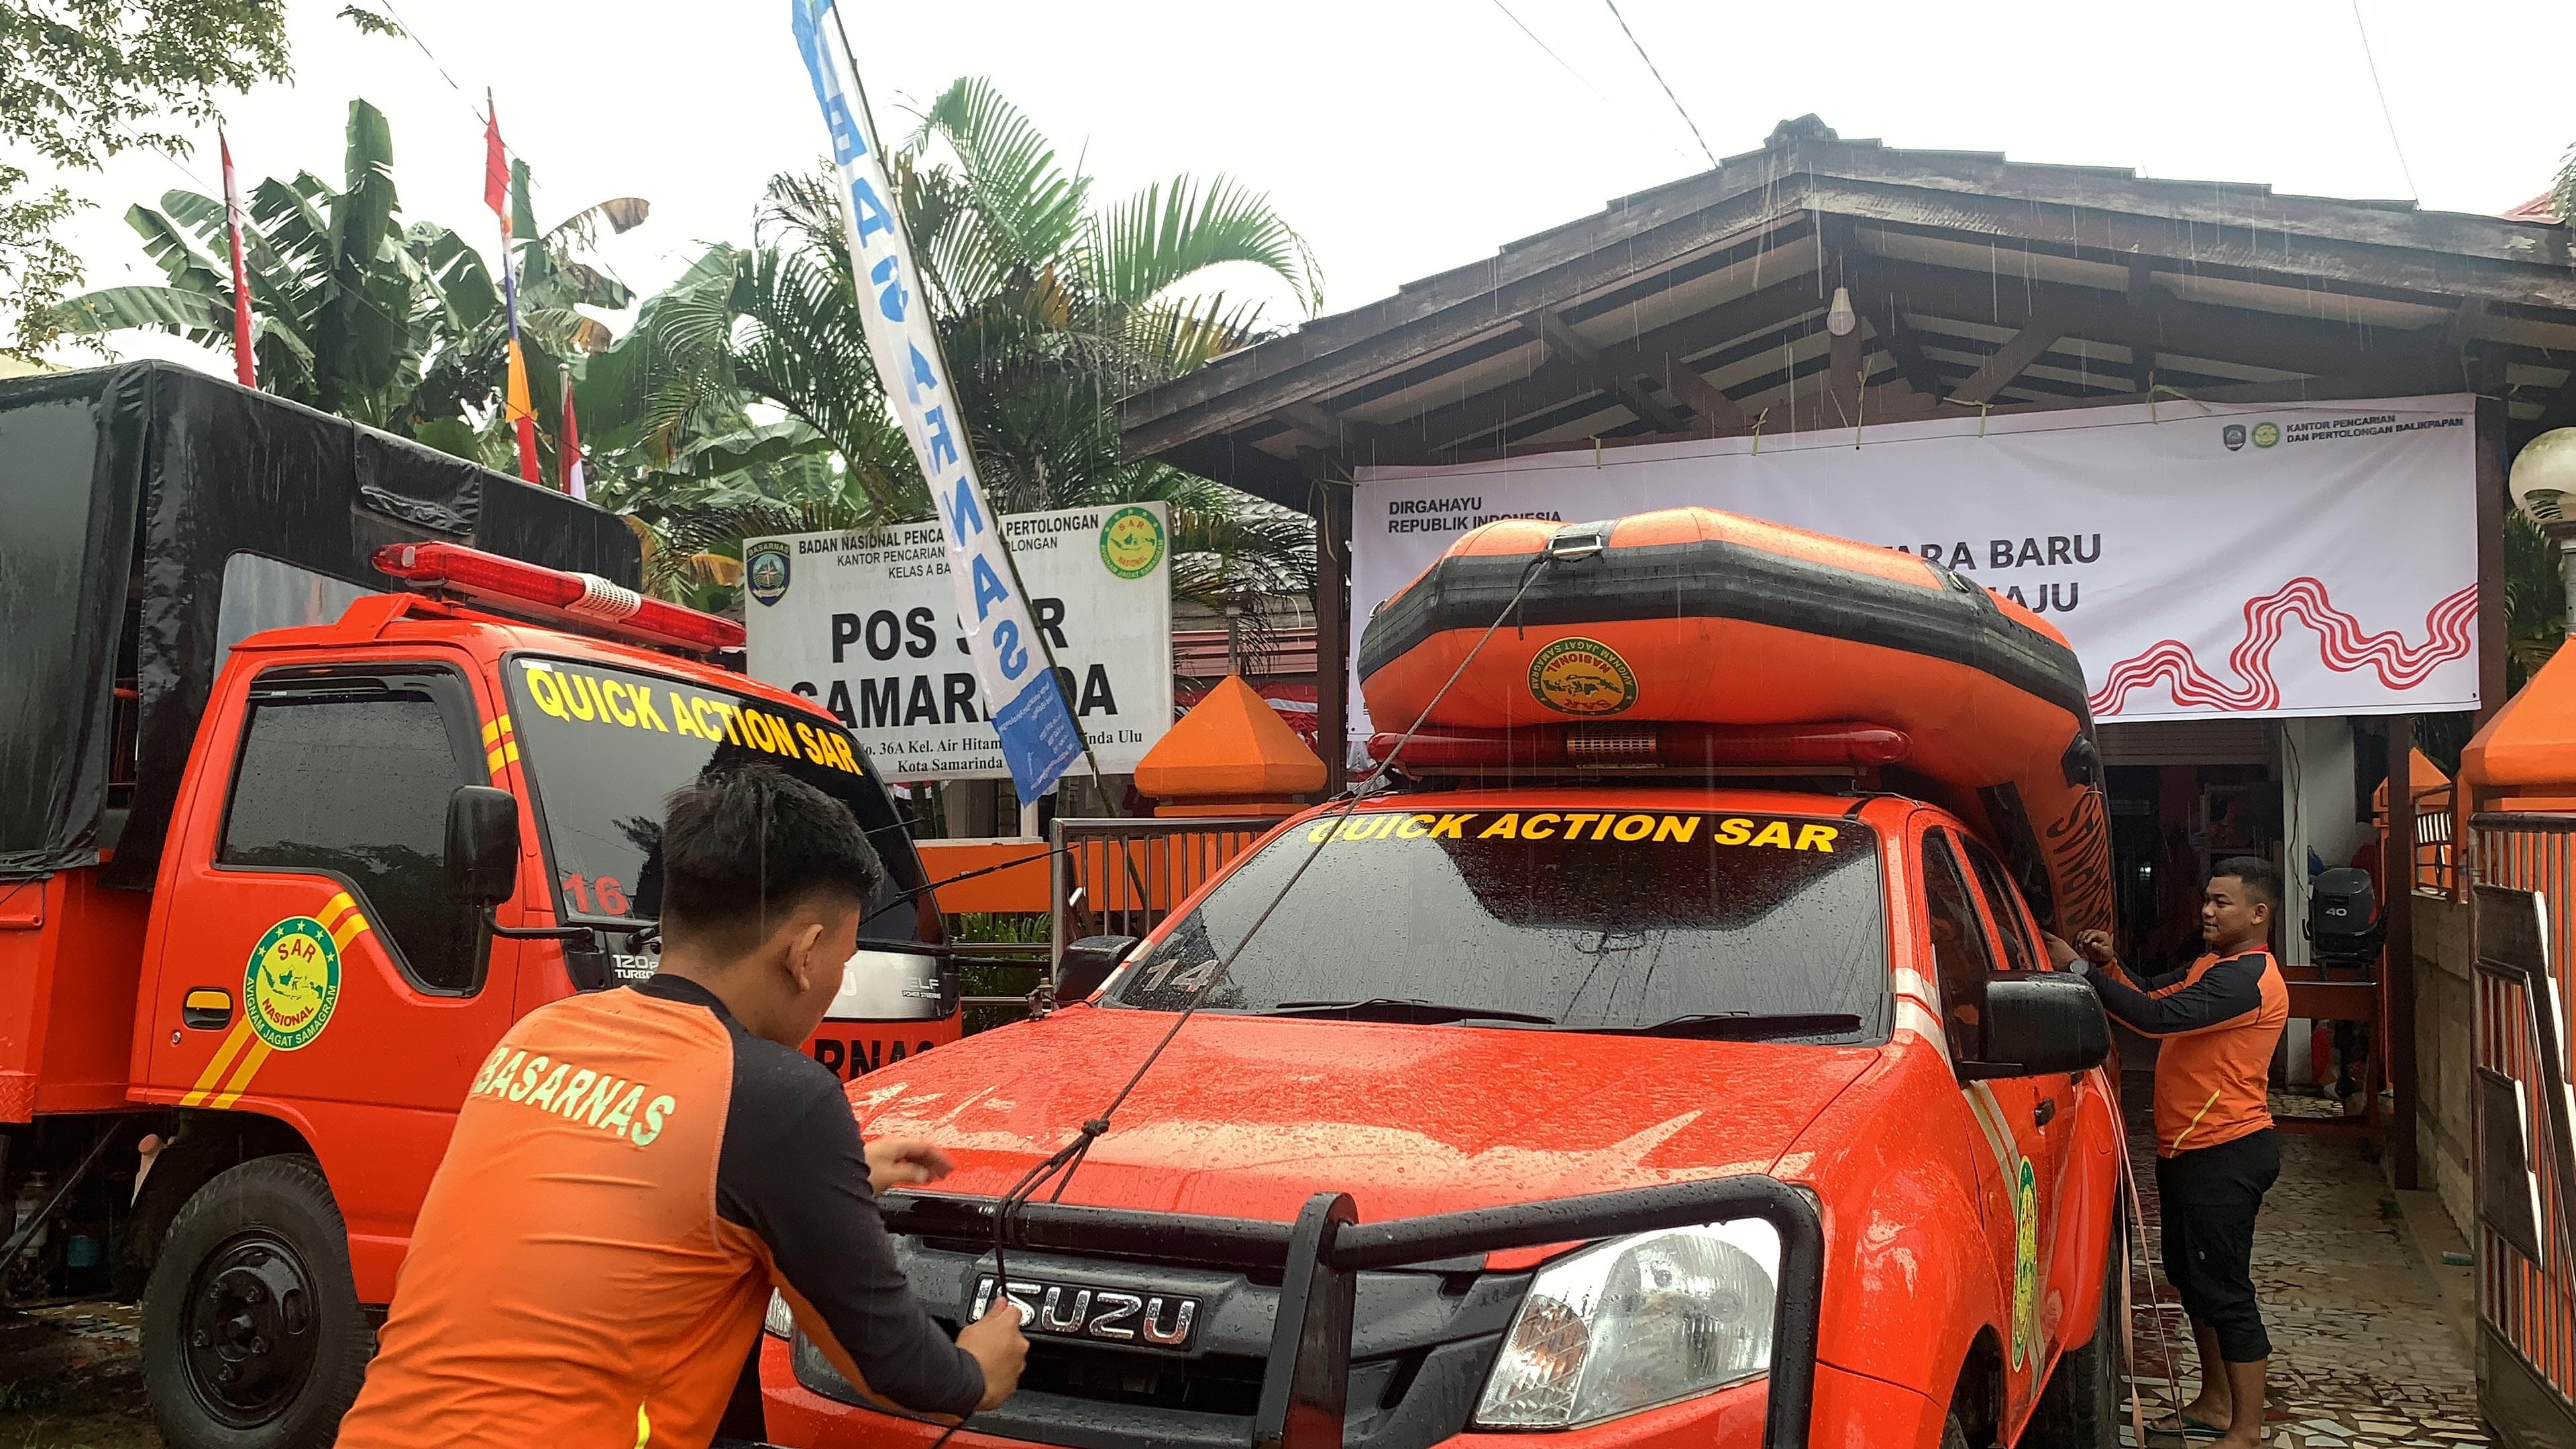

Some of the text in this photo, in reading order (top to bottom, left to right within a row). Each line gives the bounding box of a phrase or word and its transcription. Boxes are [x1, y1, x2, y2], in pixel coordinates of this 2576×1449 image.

[2286, 415, 2396, 433] KANTOR PENCARIAN
[2287, 418, 2464, 443] DAN PERTOLONGAN BALIKPAPAN
[1389, 496, 1482, 515] DIRGAHAYU
[799, 514, 1099, 554] BADAN NASIONAL PENCA PERTOLONGAN
[1118, 519, 1144, 531] SAR
[1388, 517, 1468, 533] REPUBLIK
[837, 537, 1058, 566] KANTOR PENCARIAN LONGAN
[1990, 533, 2102, 569] BARU
[889, 565, 923, 579] KELAS
[926, 564, 934, 576] A
[1988, 582, 2079, 613] AJU
[831, 606, 937, 663] POS
[1564, 641, 1599, 651] JAGAT
[1546, 653, 1611, 674] NASIONAL
[1564, 698, 1611, 710] SAR
[526, 667, 864, 776] QUICK ACTION SAR
[879, 741, 904, 755] 36A
[908, 741, 933, 753] Kel.
[937, 739, 959, 752] Air
[963, 737, 1002, 751] Hitam
[1118, 730, 1142, 743] Ulu
[898, 757, 1004, 773] Kota Samarinda
[1307, 813, 1839, 853] QUICK ACTION SAR
[562, 872, 630, 917] 16
[2325, 908, 2347, 916] 40
[278, 938, 316, 963] SAR
[614, 969, 655, 979] TURBO
[906, 977, 939, 990] ELF
[1142, 959, 1220, 992] 14
[246, 976, 337, 1046] AVIGNAM JAGAT SAMAGRAM
[262, 998, 314, 1027] NASIONAL
[472, 1047, 676, 1146] BASARNAS
[971, 1278, 1195, 1344] ISUZU
